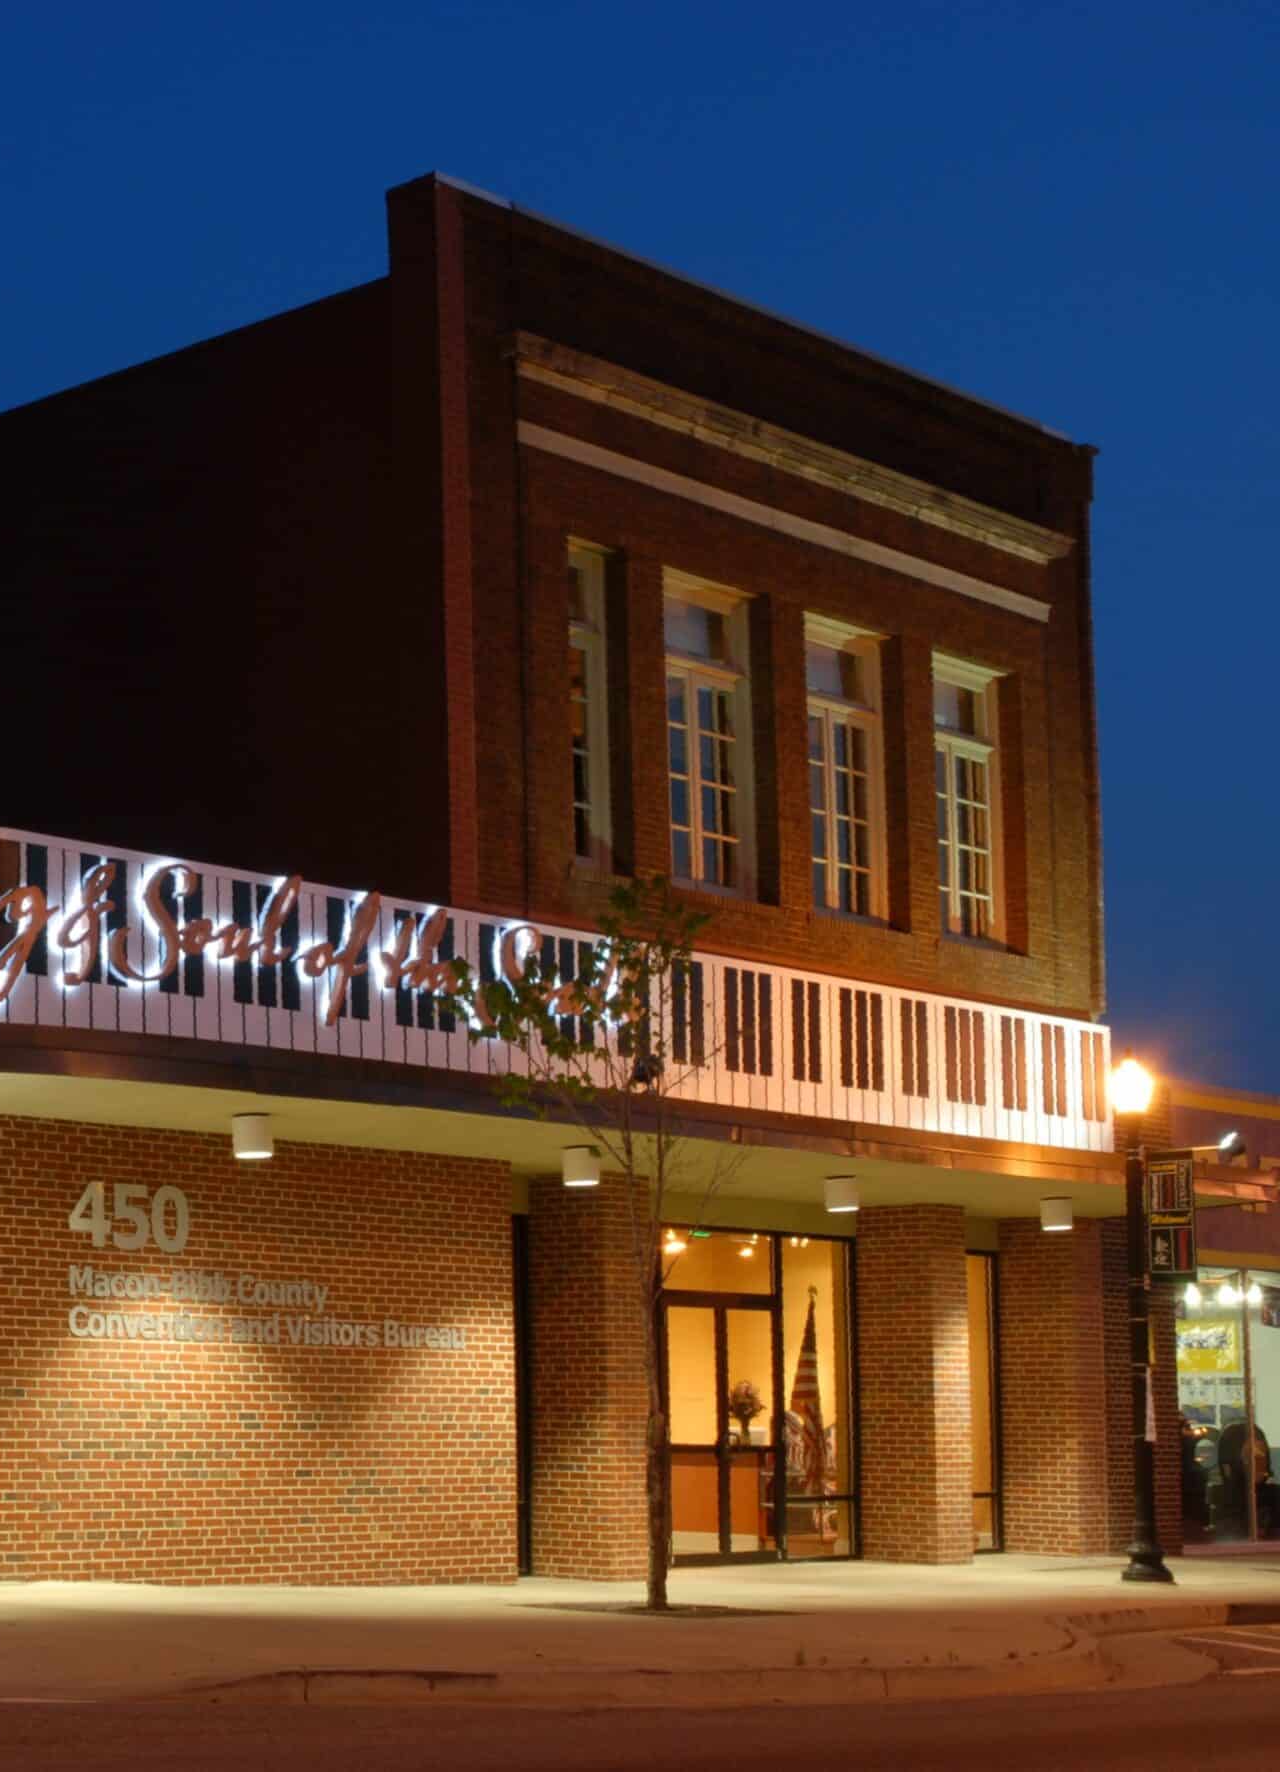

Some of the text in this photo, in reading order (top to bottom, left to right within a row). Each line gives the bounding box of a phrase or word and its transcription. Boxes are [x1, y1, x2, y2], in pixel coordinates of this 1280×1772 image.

[57, 863, 116, 986] &
[109, 863, 302, 980] Soul
[291, 891, 380, 1026] of
[380, 908, 463, 993] the
[68, 1181, 190, 1253] 450
[69, 1264, 329, 1312] Macon-Bibb County
[68, 1304, 467, 1351] Convention and Visitors Bureau
